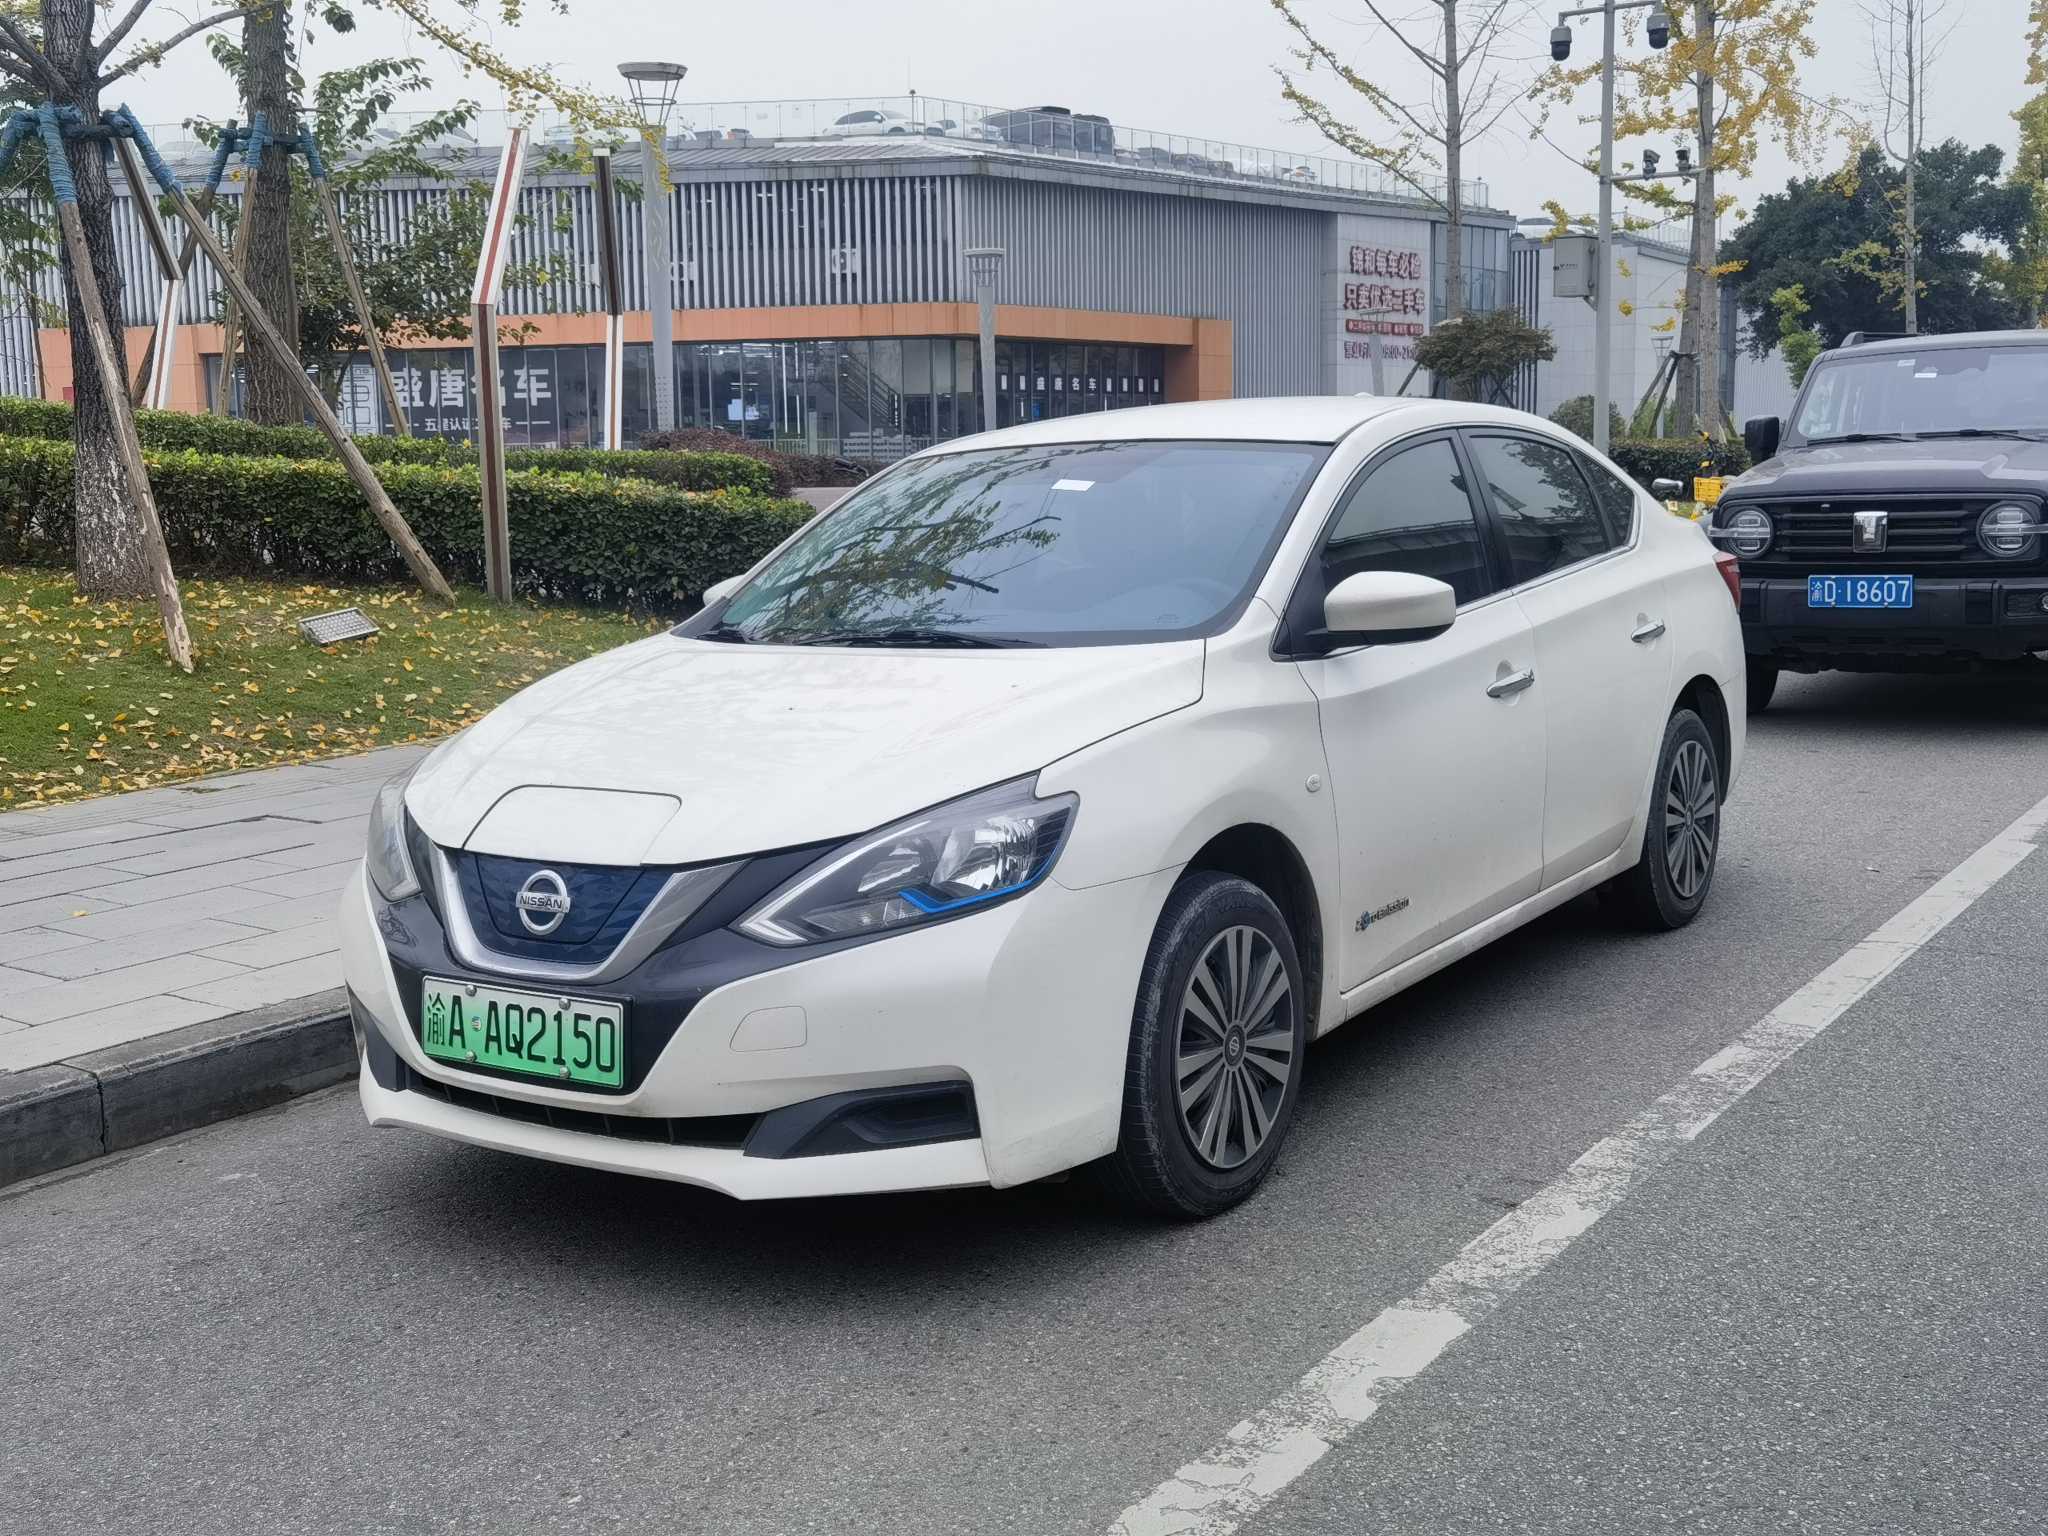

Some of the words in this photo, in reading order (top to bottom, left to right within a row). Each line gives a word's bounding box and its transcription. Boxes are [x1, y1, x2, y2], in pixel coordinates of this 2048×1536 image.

[1344, 283, 1425, 314] 只卖优选二手车
[424, 417, 512, 432] 五星认证车
[520, 895, 563, 908] NISSAN
